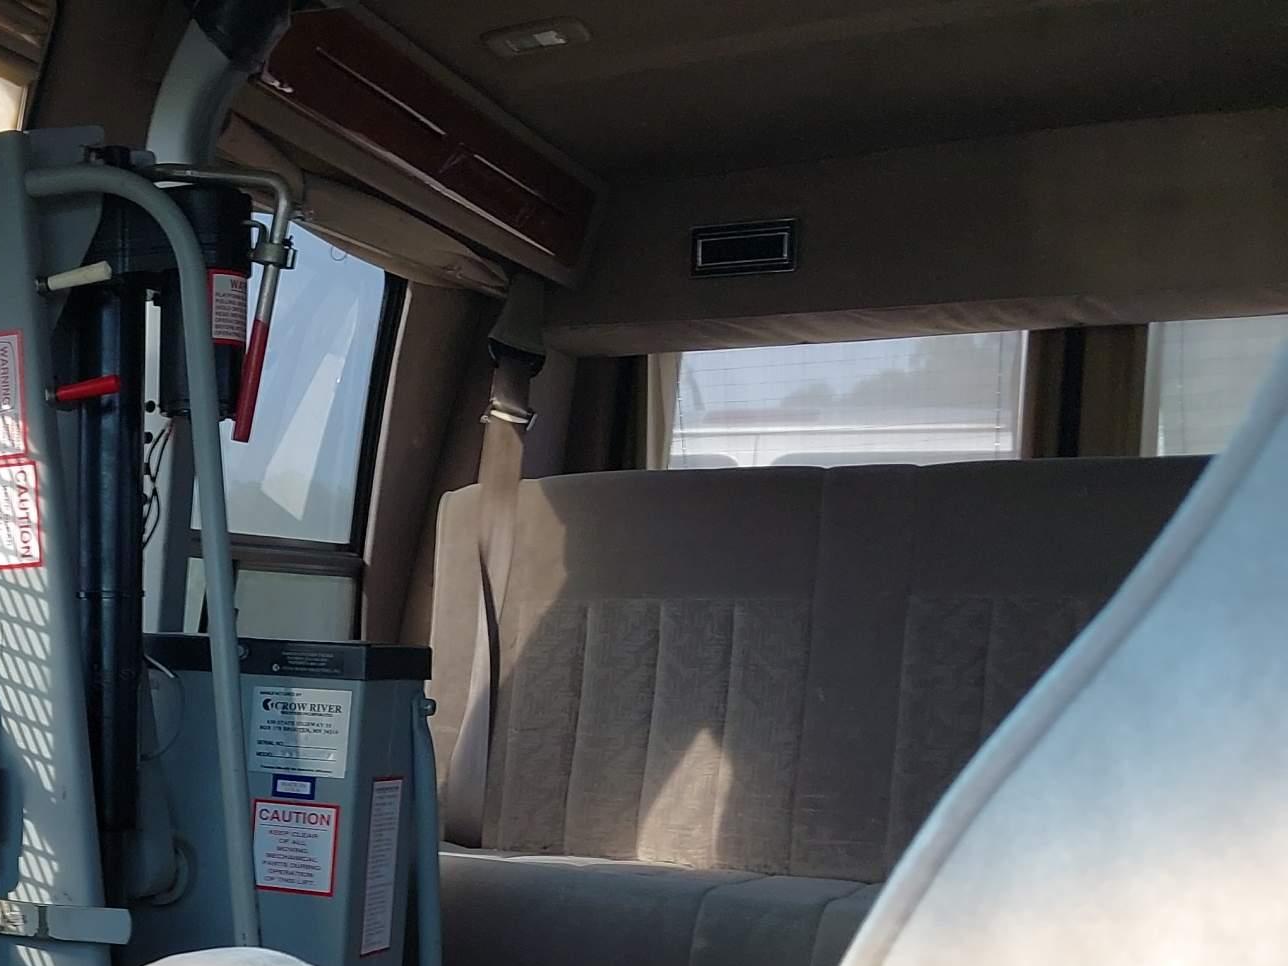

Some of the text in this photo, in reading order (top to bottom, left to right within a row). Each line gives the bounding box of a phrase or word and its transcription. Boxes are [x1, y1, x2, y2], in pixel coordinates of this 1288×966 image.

[0, 346, 12, 406] WARNING
[15, 469, 34, 559] CAUTION
[275, 701, 307, 712] CROW
[309, 703, 343, 714] RIVER
[258, 808, 332, 827] CAUTION
